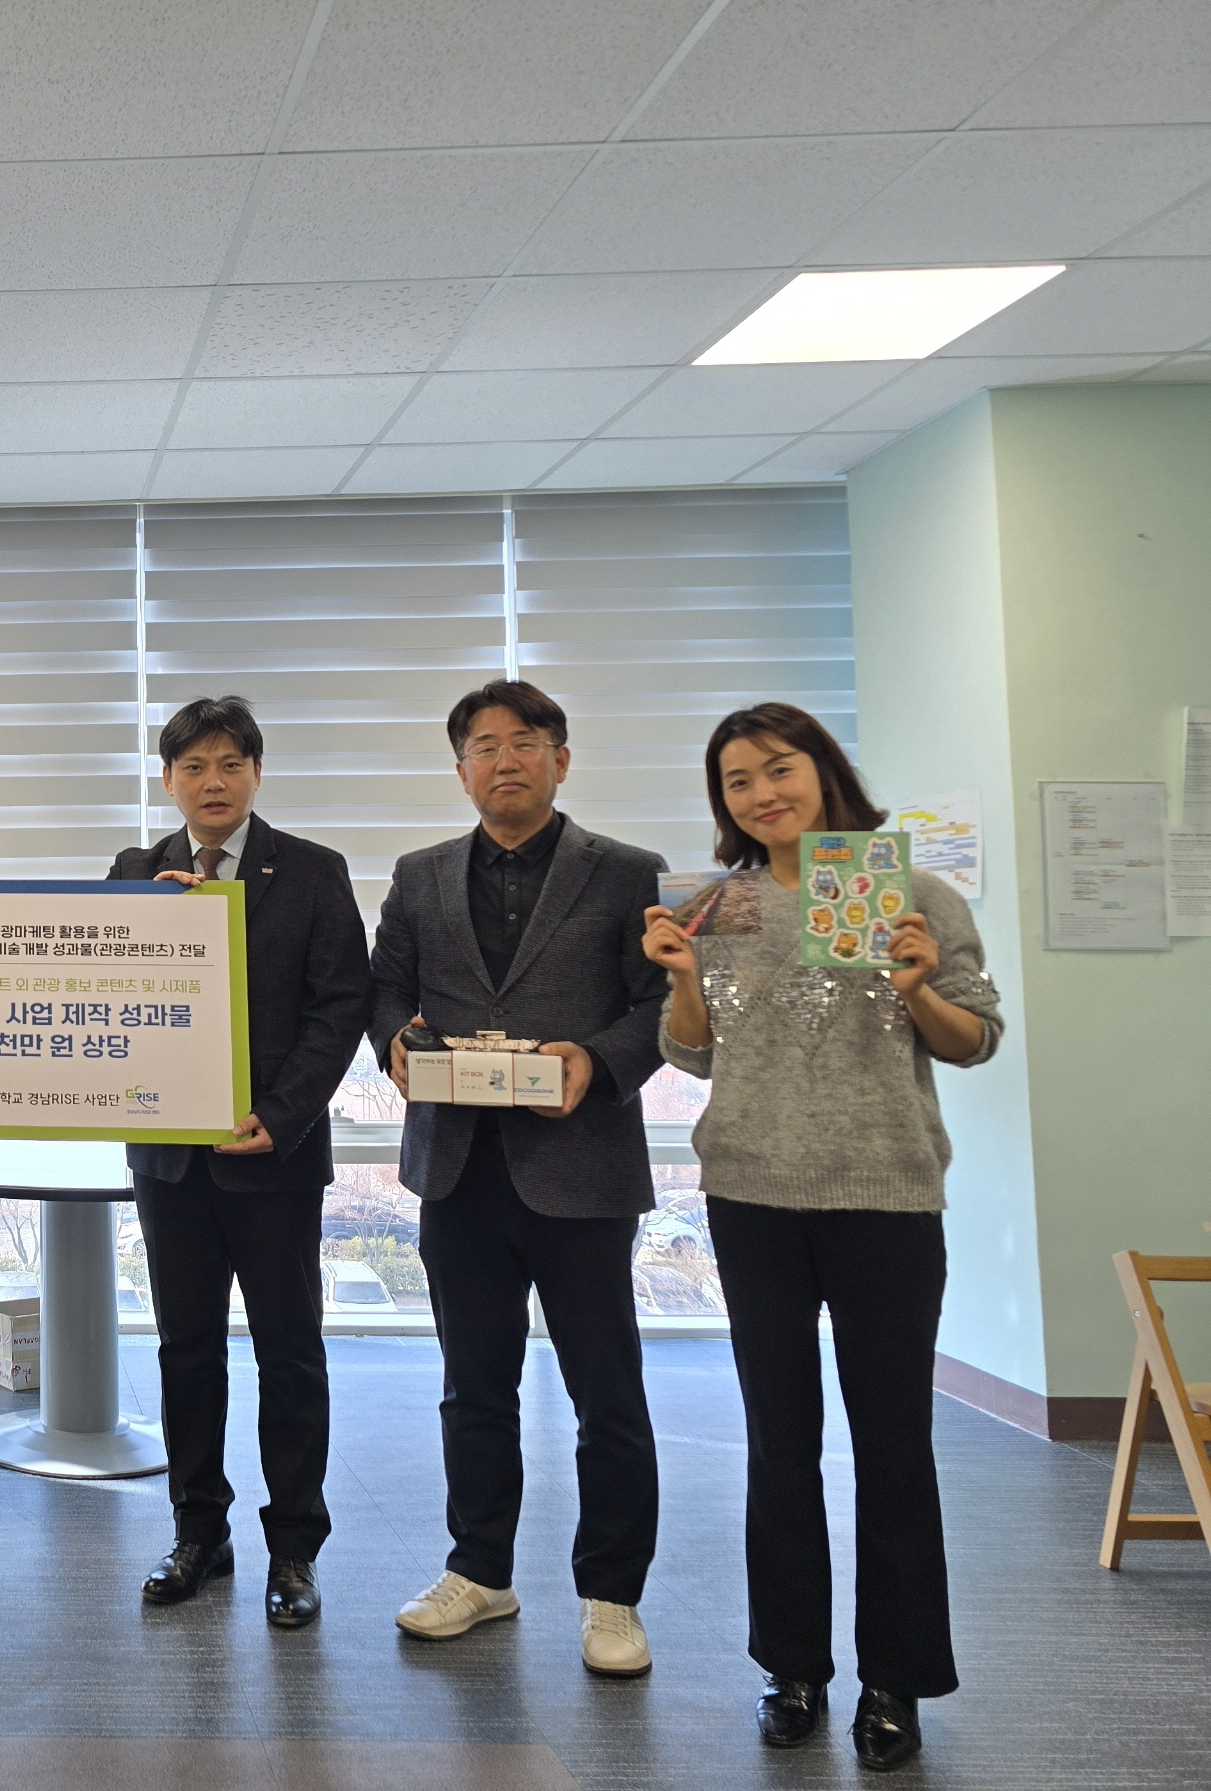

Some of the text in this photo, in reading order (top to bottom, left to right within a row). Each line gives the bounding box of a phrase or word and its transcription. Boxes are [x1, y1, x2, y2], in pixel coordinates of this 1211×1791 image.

[59, 925, 99, 938] 활용을
[104, 926, 130, 939] 위한
[53, 943, 174, 957] 성과물(관광콘텐츠)
[179, 944, 206, 957] 전달
[16, 978, 28, 991] 외
[33, 978, 61, 992] 관광
[65, 978, 91, 992] 홍보
[96, 979, 137, 992] 콘텐츠
[142, 979, 155, 992] 및
[160, 979, 200, 993] 시제품
[6, 1003, 52, 1025] 사업
[61, 1003, 111, 1026] 제작
[119, 1004, 191, 1027] 성과물
[50, 1035, 73, 1057] 원
[82, 1035, 130, 1058] 상당
[28, 1093, 79, 1105] 경남RISE
[84, 1094, 120, 1106] 사업단
